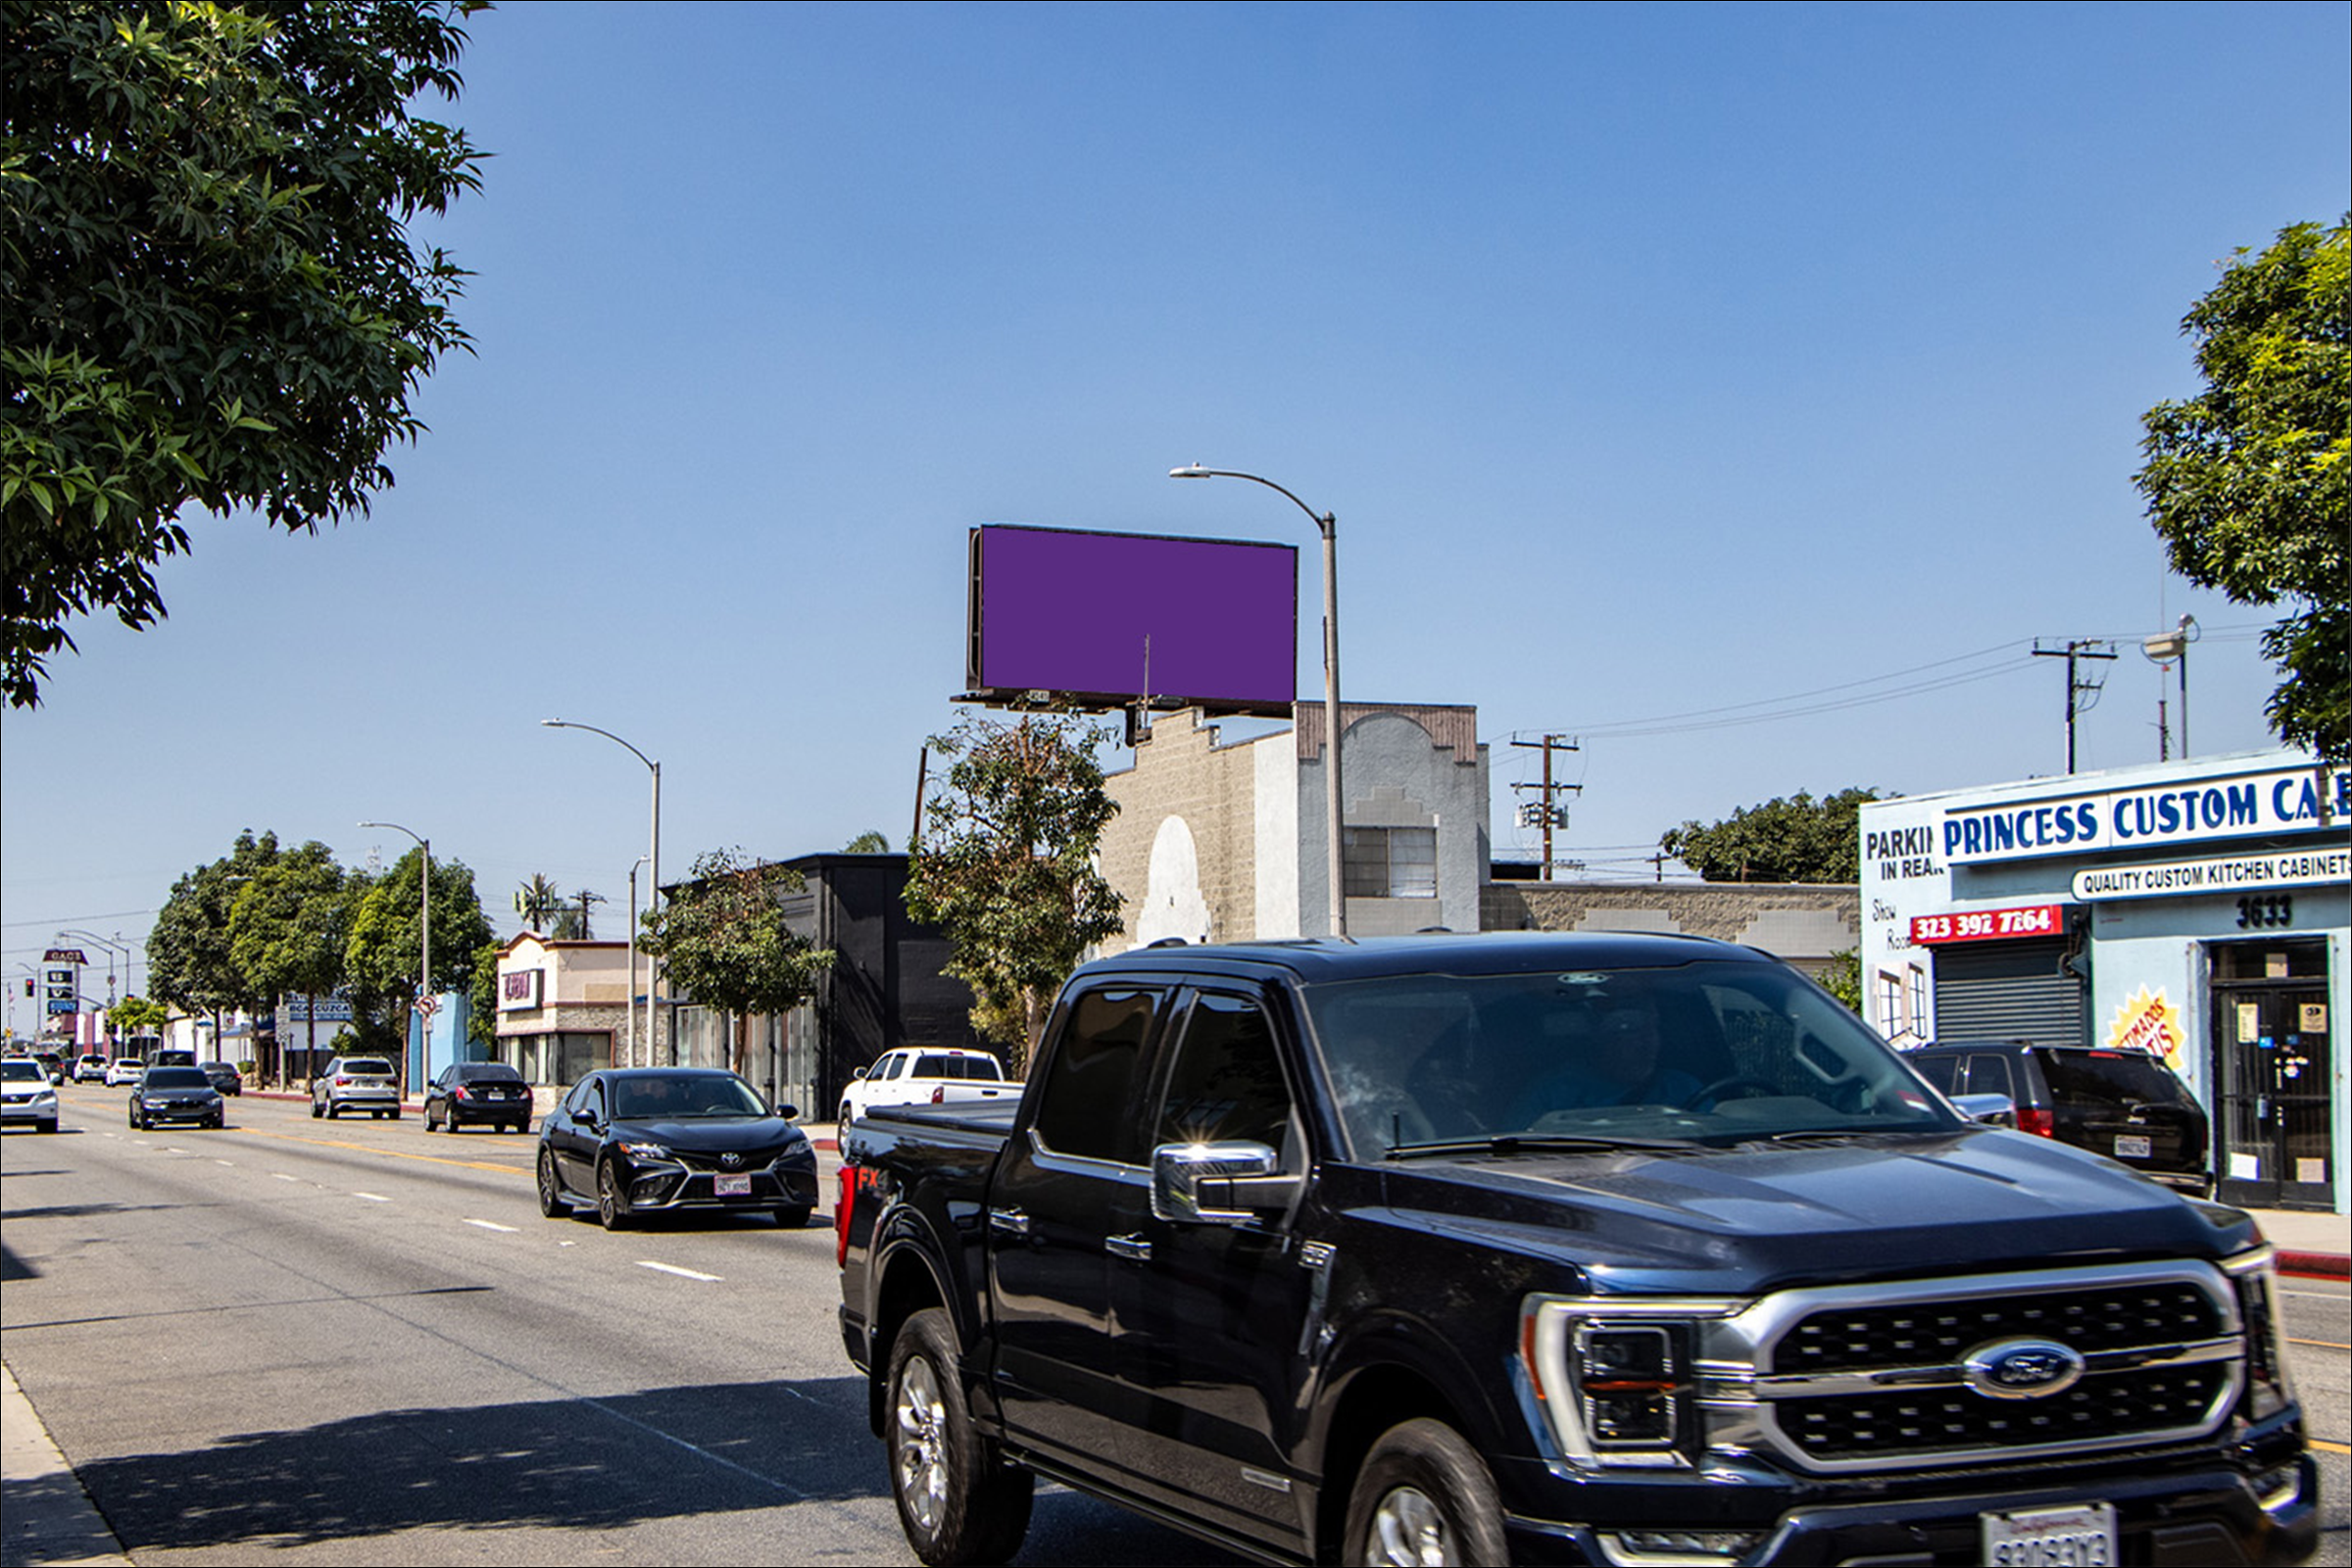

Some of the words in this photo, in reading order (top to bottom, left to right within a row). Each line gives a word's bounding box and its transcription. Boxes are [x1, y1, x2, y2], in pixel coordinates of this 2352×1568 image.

[1943, 803, 2098, 857] PRINCESS
[2114, 783, 2258, 839] CUSTOM
[1881, 861, 1896, 880] IN
[2083, 871, 2141, 893] QUALITY
[2145, 866, 2203, 888] CUSTOM
[2208, 860, 2274, 883] KITCHEN
[1872, 899, 1896, 921] Show
[1916, 918, 1951, 939] 323
[1956, 913, 1993, 935] 392
[1998, 908, 2051, 932] 7264
[2235, 894, 2292, 929] 3633
